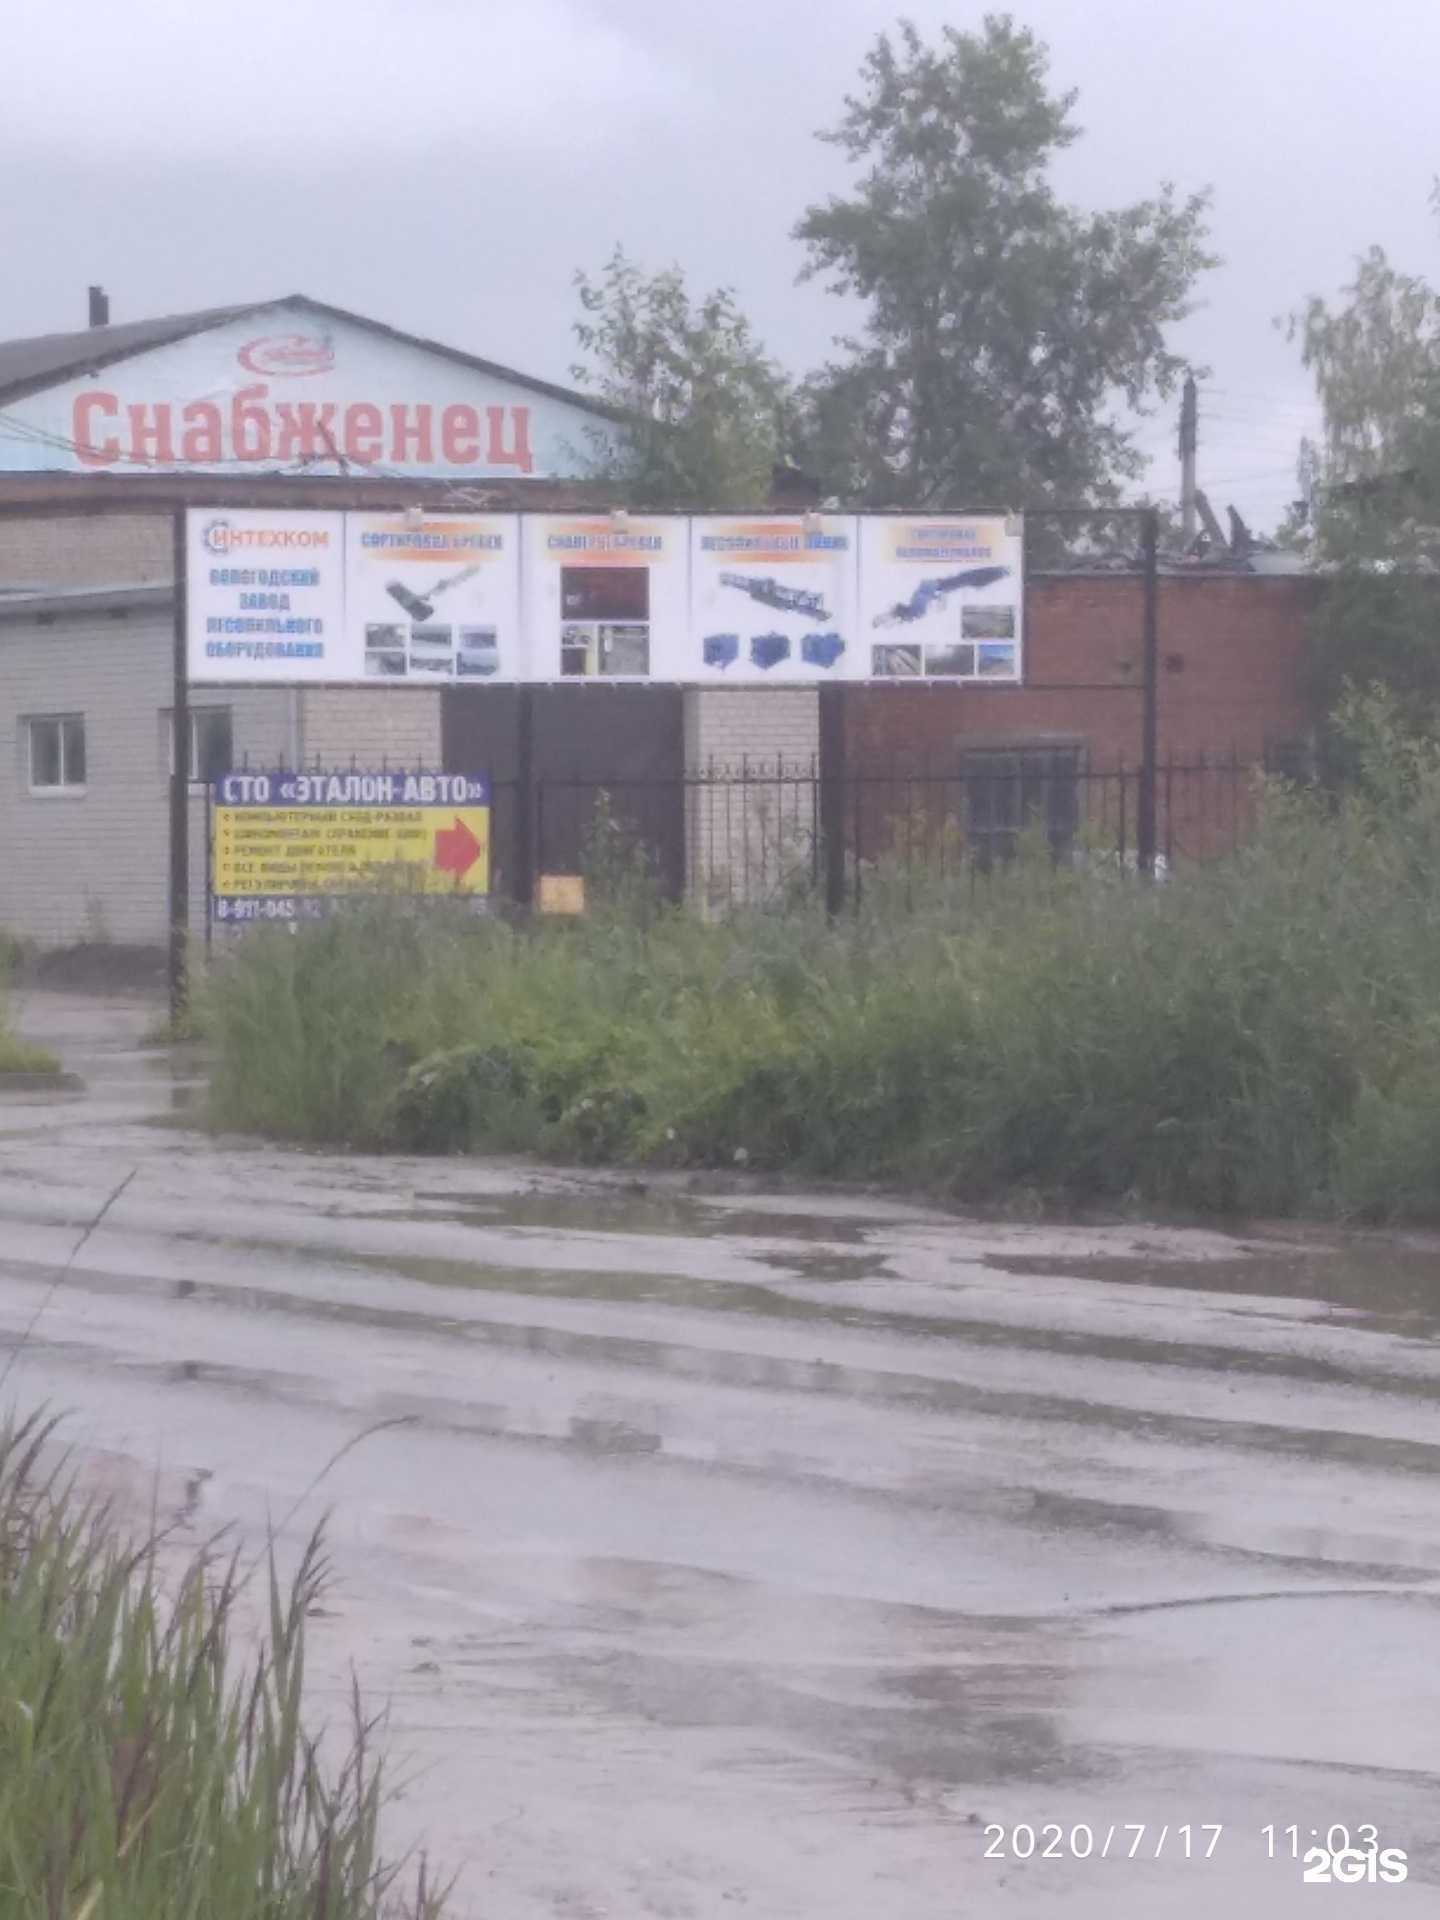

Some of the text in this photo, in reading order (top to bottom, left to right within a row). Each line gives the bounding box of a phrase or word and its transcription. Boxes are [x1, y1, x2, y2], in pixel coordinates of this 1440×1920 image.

[72, 384, 532, 473] Снабженец
[213, 528, 329, 549] ИНТЕХКОМ
[239, 592, 291, 611] ЗАВОД
[223, 775, 484, 803] СТО «ЭТАЛОН-АВТО»
